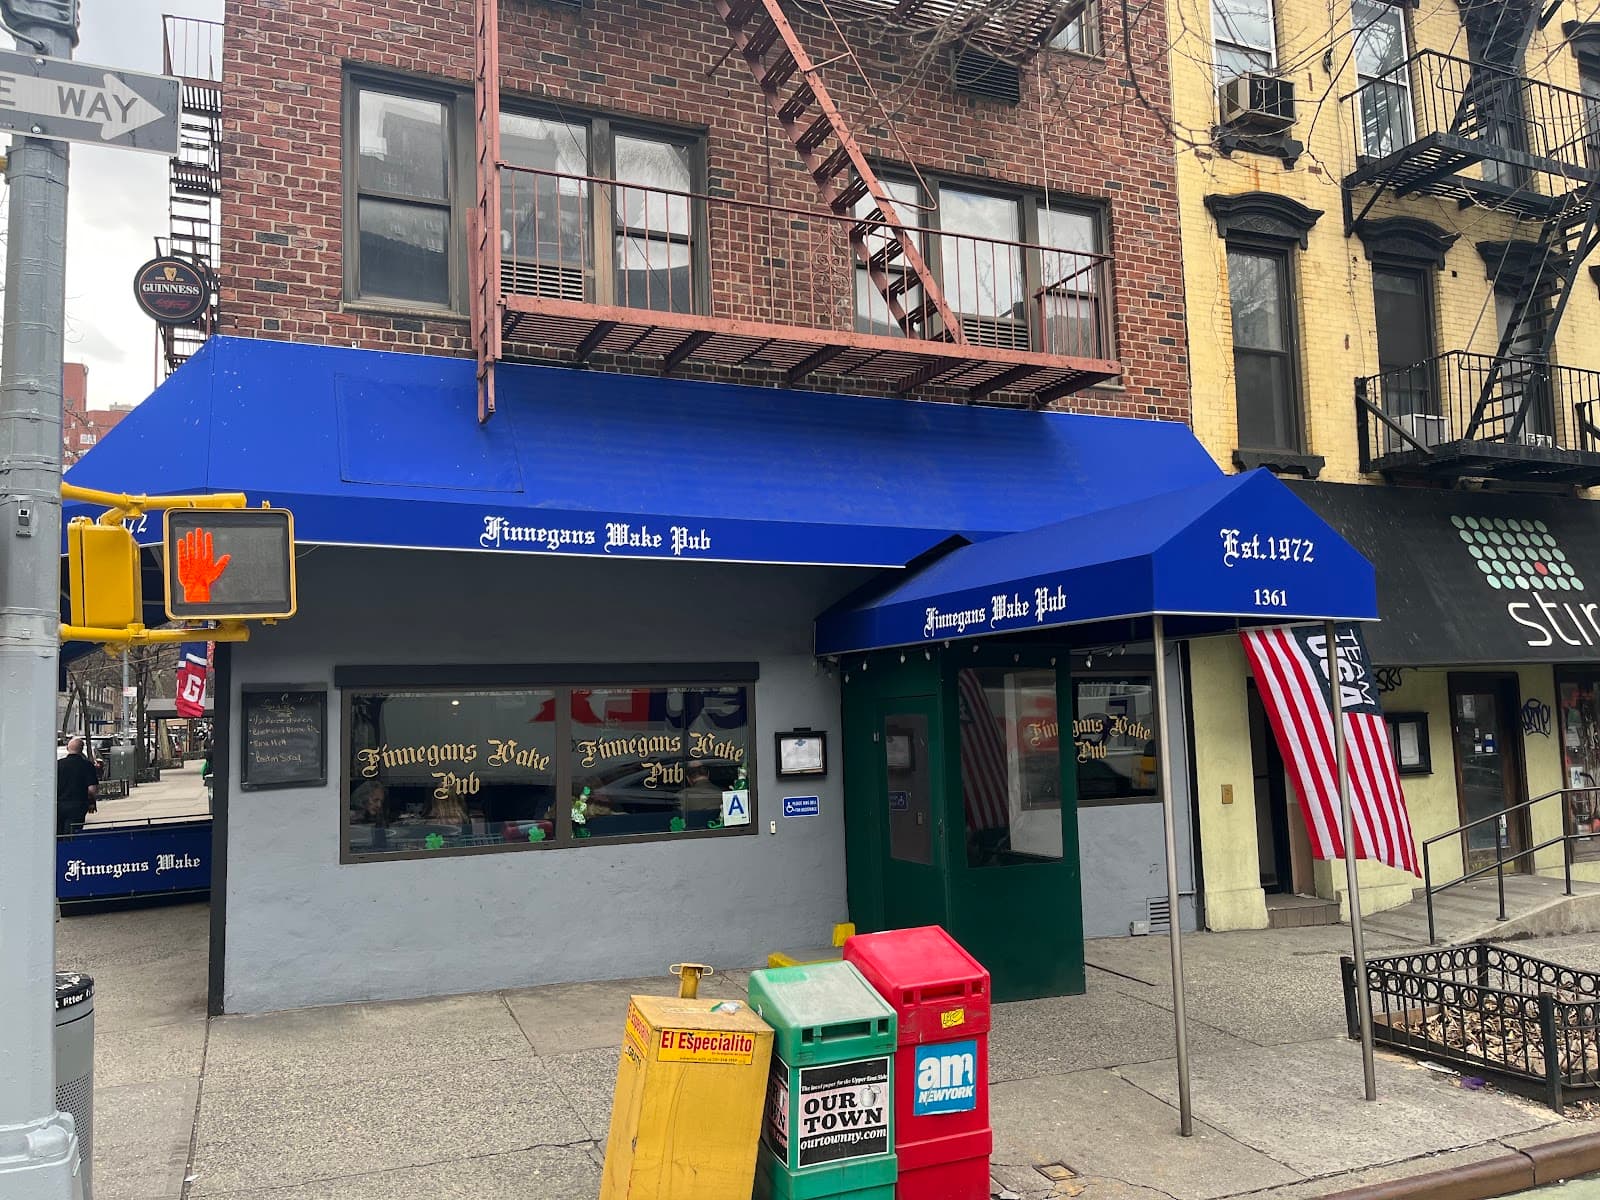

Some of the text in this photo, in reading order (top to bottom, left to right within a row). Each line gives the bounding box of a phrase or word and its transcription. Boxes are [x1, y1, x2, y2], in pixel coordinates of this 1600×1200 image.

[57, 86, 138, 123] WAY
[142, 283, 200, 295] GUINNESS
[479, 515, 711, 556] Finnegans Wake Pub
[1219, 528, 1315, 568] Est.1972
[923, 585, 1067, 638] Finnegans Wake Pub
[1253, 589, 1288, 607] 1361
[1306, 633, 1363, 708] USA
[1339, 629, 1376, 706] TEAM
[1108, 715, 1151, 740] Wake
[357, 739, 551, 778] Finnegans Wake
[577, 732, 744, 768] Finnegans Wake
[1074, 740, 1107, 764] Pub
[431, 770, 480, 800] Pub
[641, 761, 684, 789] Pub
[727, 794, 745, 816] A
[65, 853, 200, 882] Finnegans Wake
[661, 1030, 675, 1049] El
[678, 1031, 752, 1054] Especialito
[917, 1053, 974, 1090] am
[804, 1092, 858, 1115] OUR
[803, 1107, 883, 1134] TOWN
[800, 1128, 887, 1150] ourtownny.com
